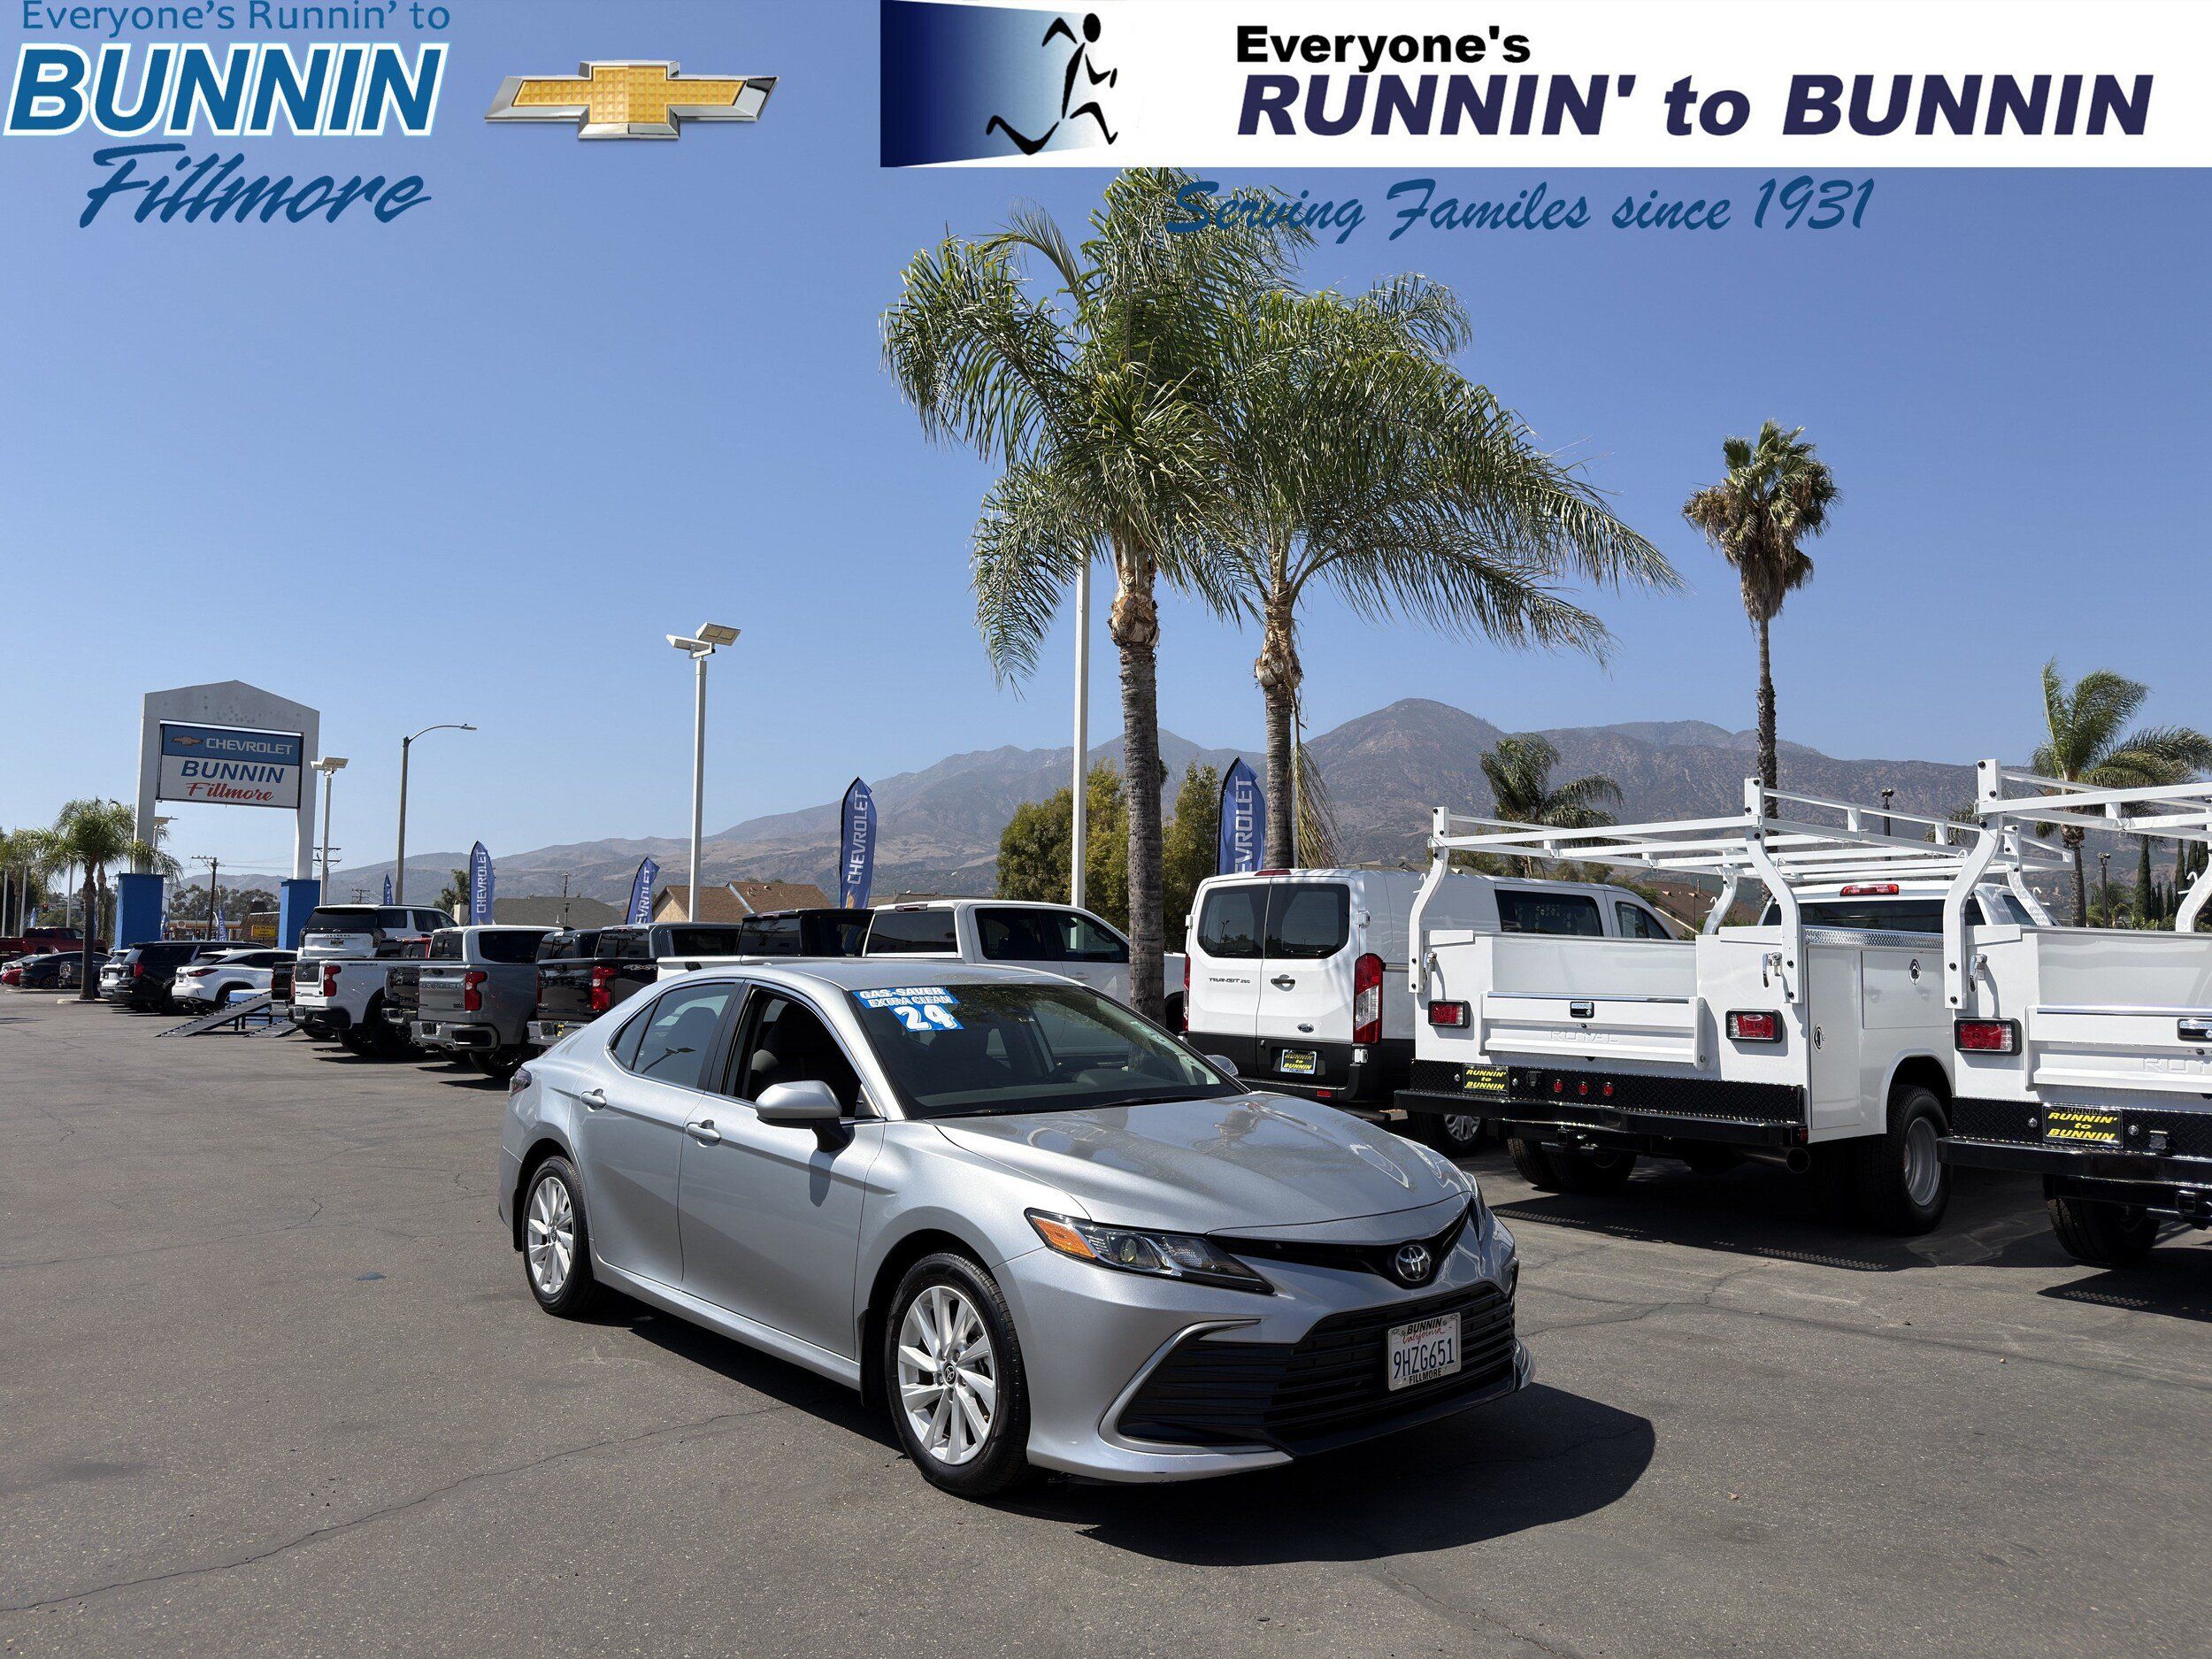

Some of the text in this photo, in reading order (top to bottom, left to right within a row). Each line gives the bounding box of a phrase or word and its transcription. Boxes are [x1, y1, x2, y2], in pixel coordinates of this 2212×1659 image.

[205, 738, 293, 755] CHEVROLET
[180, 760, 284, 783] BUNNIN
[186, 782, 274, 802] Fillmore
[1235, 776, 1253, 874] EVROLET
[847, 790, 869, 885] CHEVROLET
[476, 849, 488, 914] CHEVROLET
[859, 987, 946, 999] GAS-SAVER
[867, 995, 954, 1008] EXTRA CLEAN
[894, 1004, 958, 1030] 24
[1551, 1031, 1619, 1044] ROYAL
[2143, 1058, 2212, 1075] ROY
[2047, 1112, 2118, 1124] RUNNIN'
[2048, 1128, 2116, 1140] BUNNIN
[1407, 1317, 1442, 1334] BUNNIN
[1394, 1338, 1455, 1379] 9HZG651
[1409, 1367, 1442, 1385] FILLMORE
